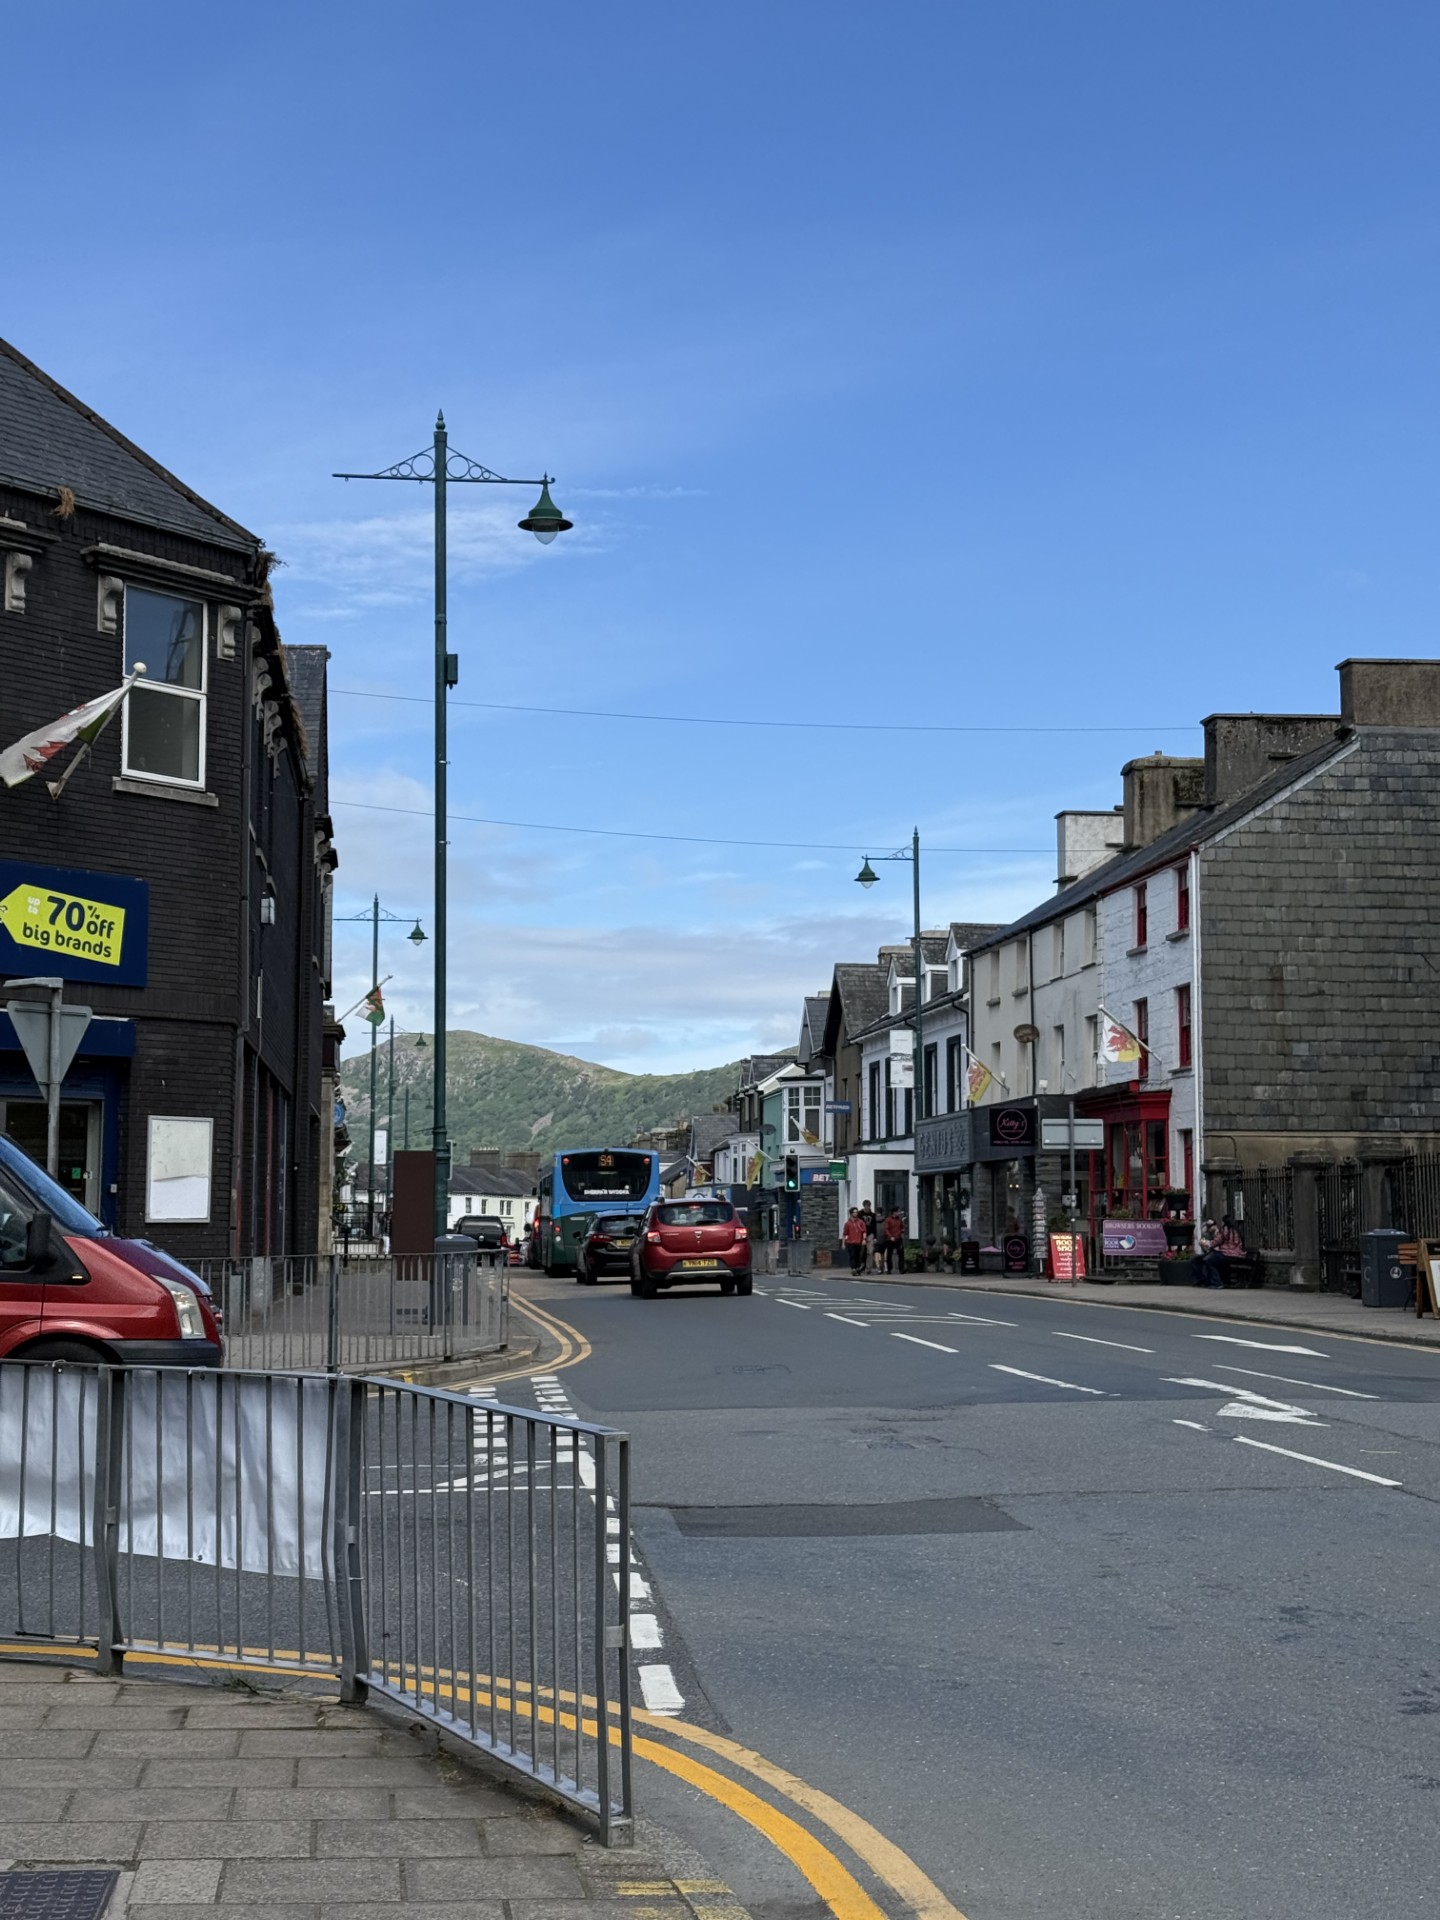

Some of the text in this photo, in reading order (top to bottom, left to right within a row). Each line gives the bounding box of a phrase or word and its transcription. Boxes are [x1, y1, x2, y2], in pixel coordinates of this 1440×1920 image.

[22, 922, 112, 958] big brands
[86, 918, 115, 940] off
